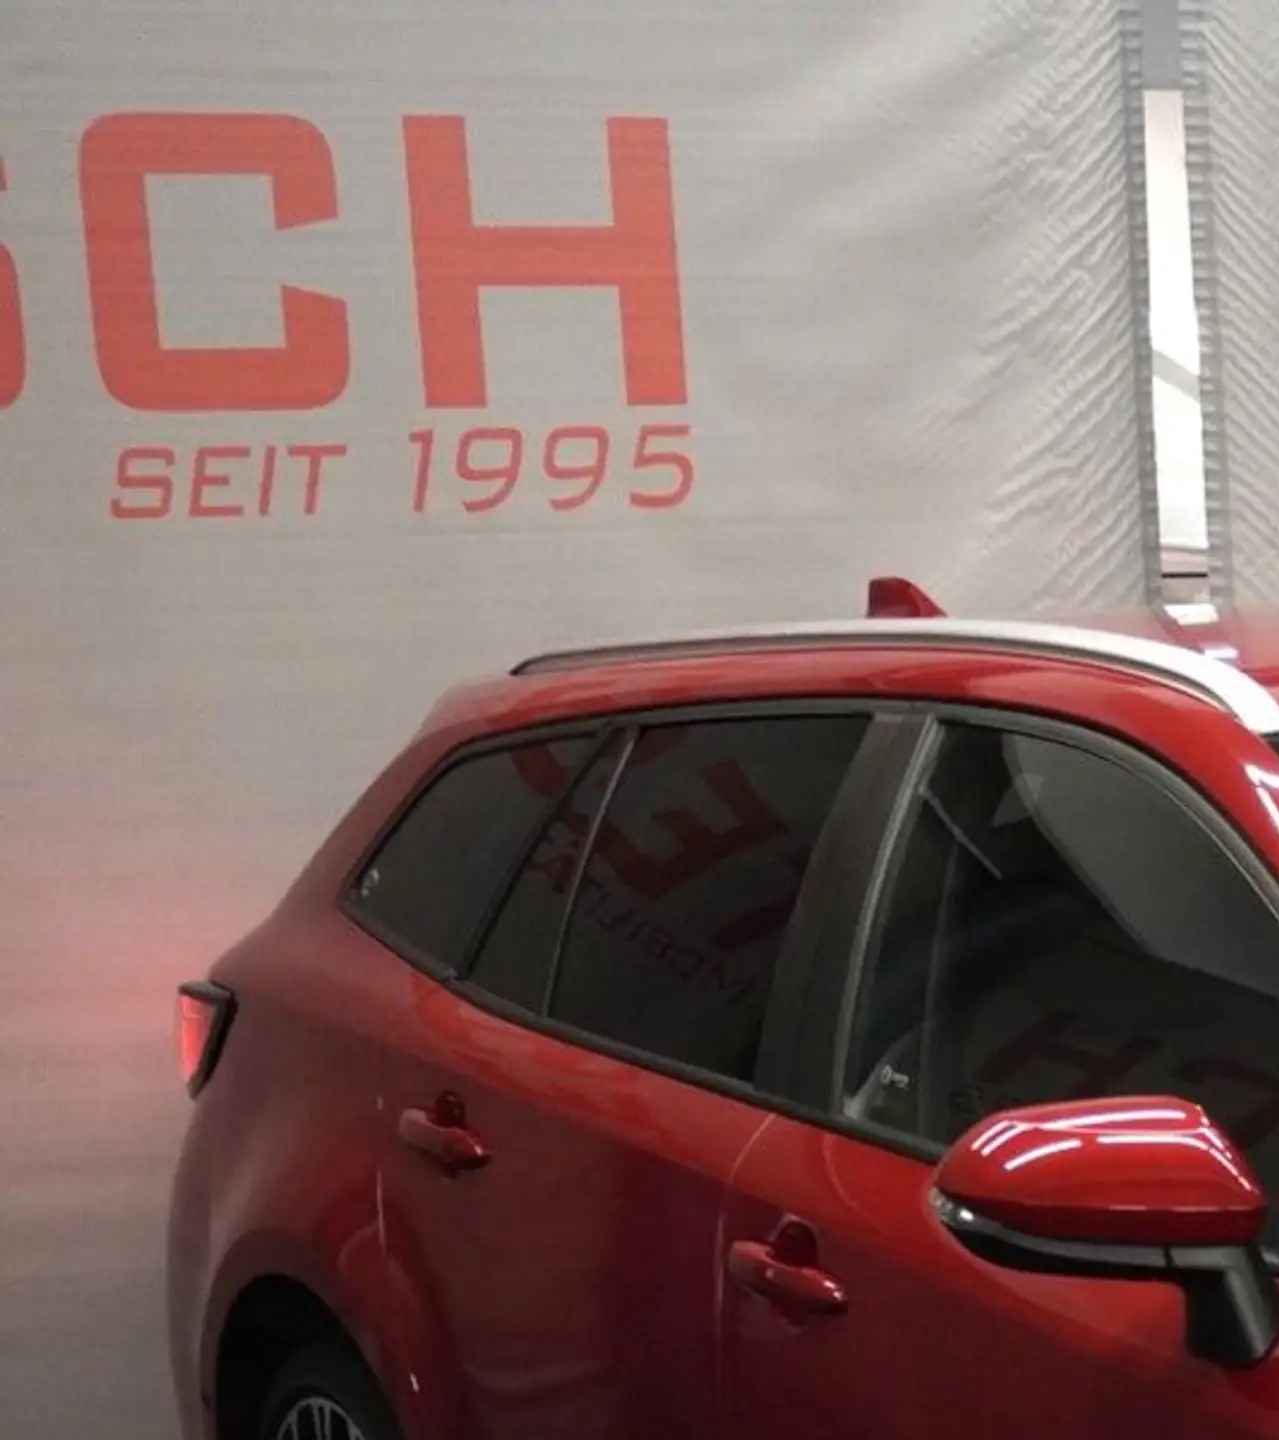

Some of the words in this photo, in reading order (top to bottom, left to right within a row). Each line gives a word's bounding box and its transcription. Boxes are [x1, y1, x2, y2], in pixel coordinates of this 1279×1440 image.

[0, 110, 691, 414] CH
[107, 442, 348, 522] SEIT
[409, 421, 697, 517] 1995
